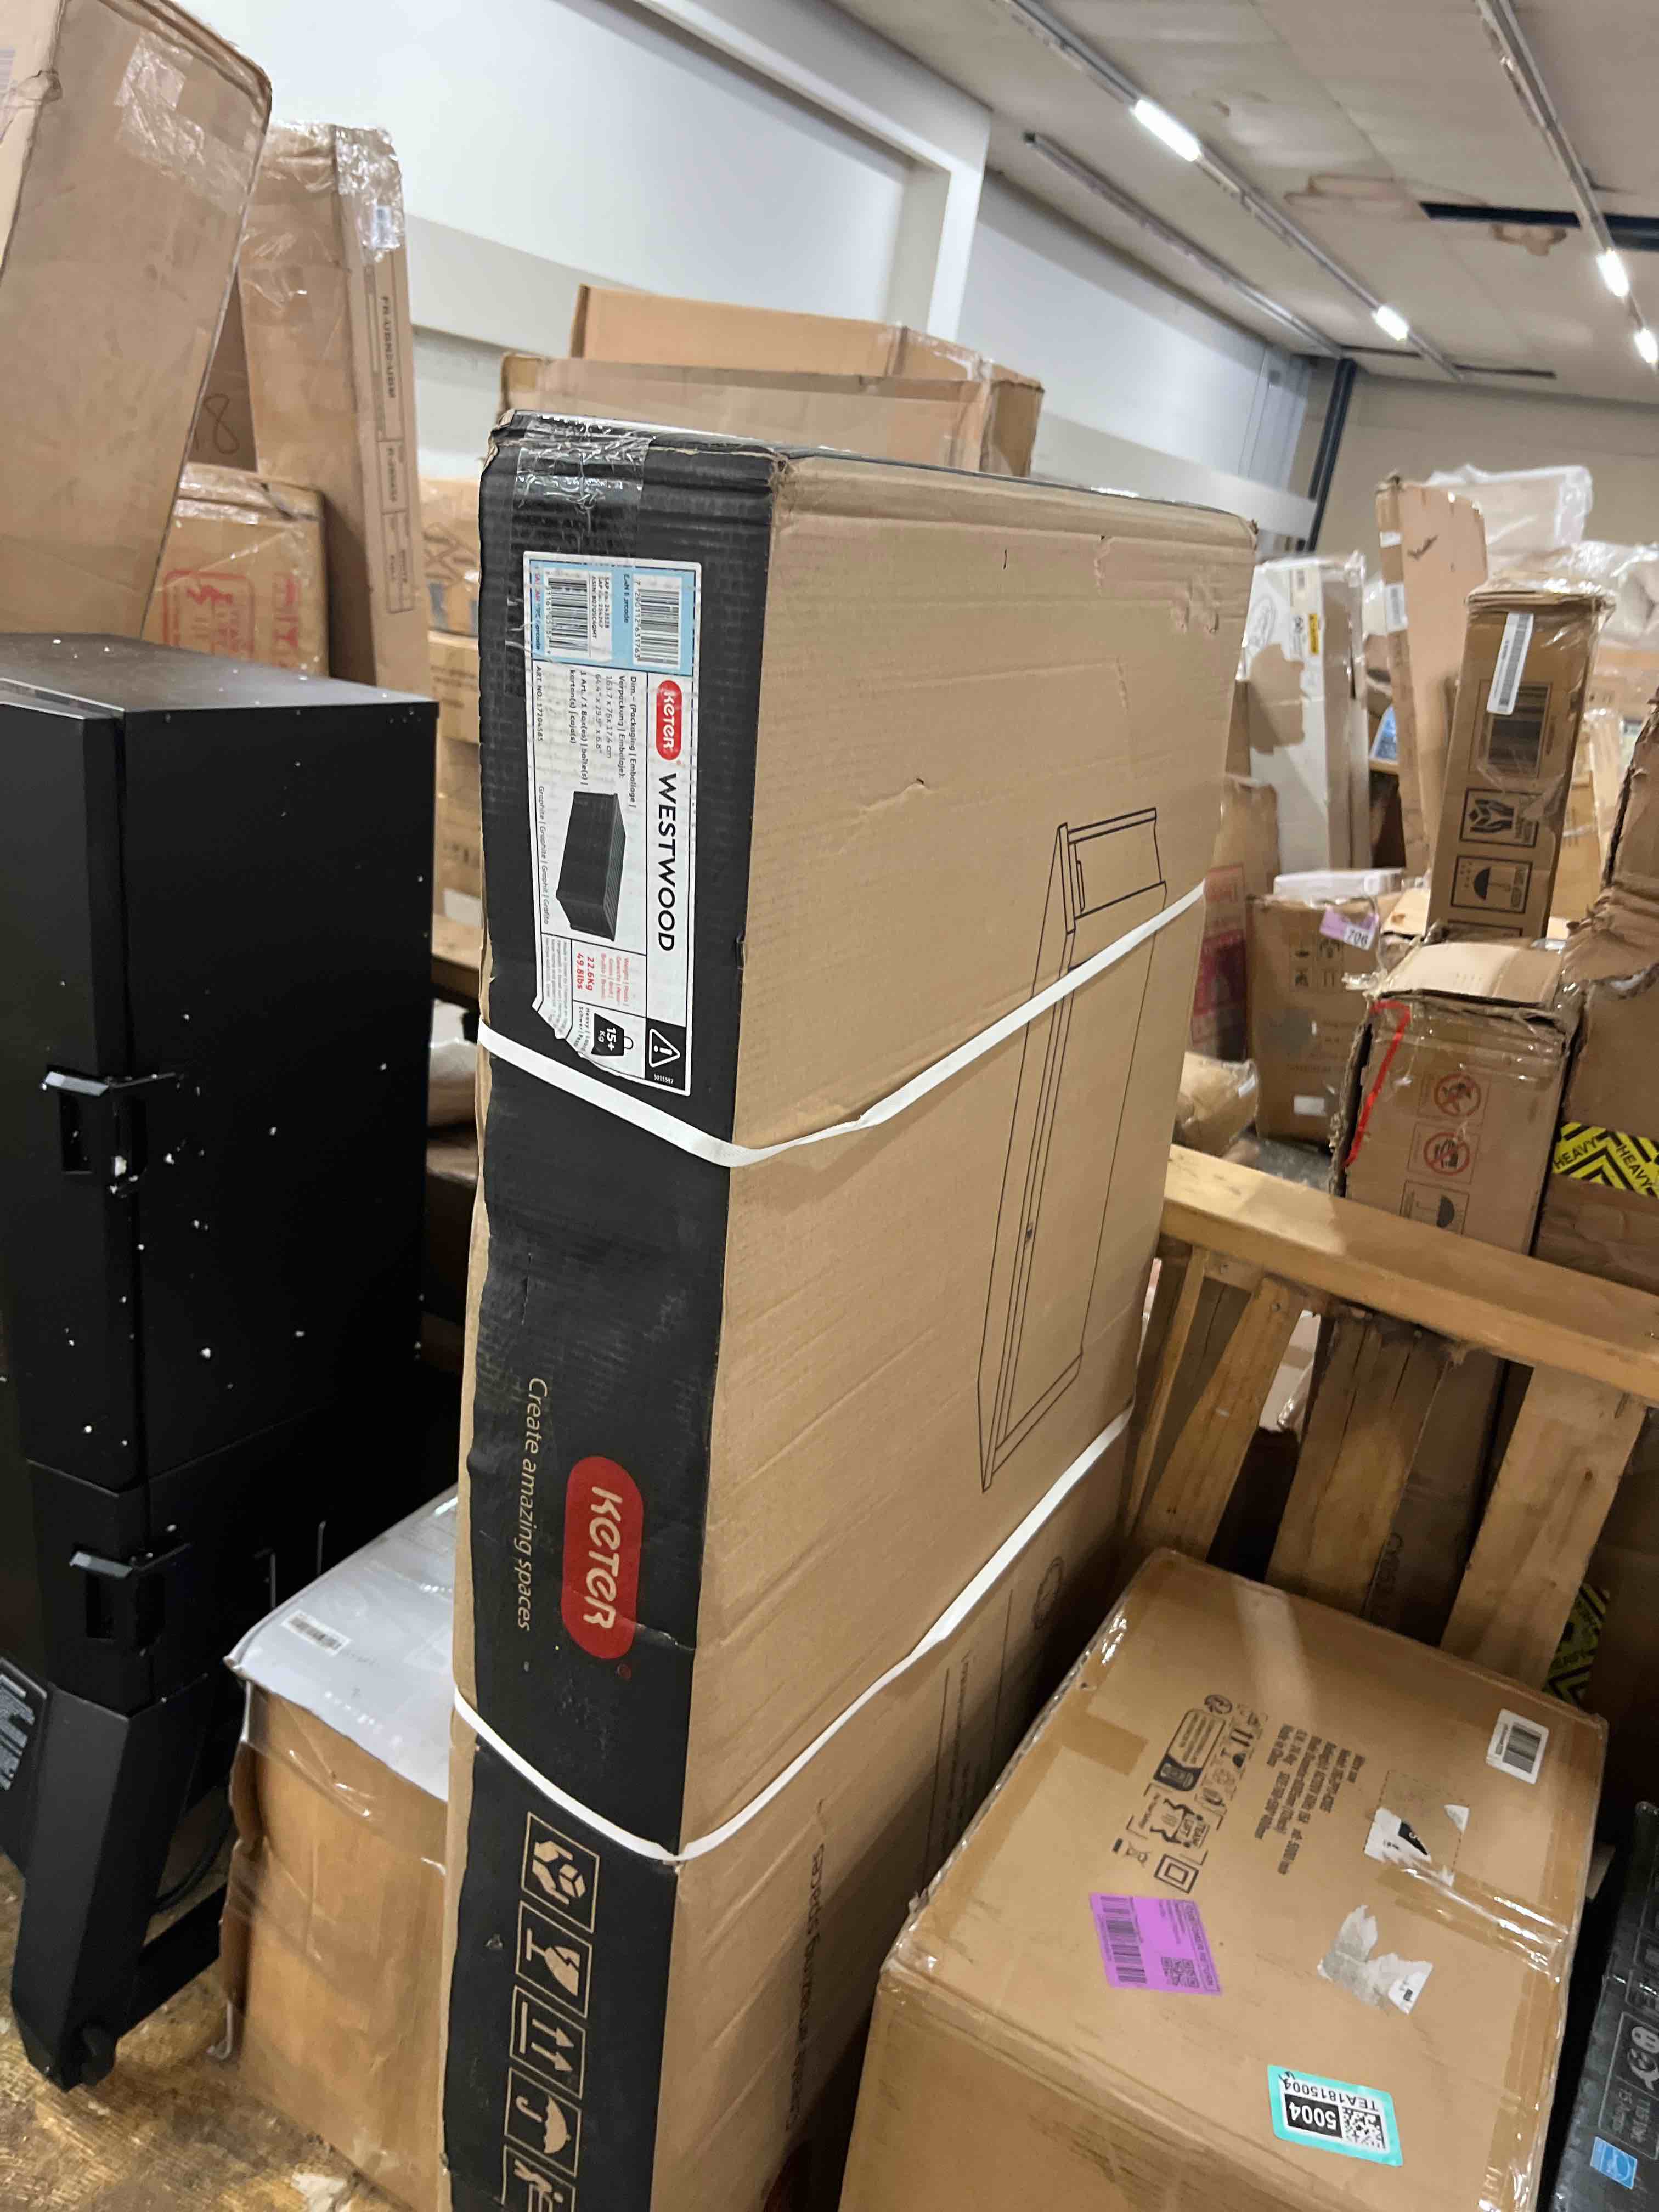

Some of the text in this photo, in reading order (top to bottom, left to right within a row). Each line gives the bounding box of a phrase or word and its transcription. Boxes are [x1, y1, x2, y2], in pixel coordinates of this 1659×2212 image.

[606, 746, 611, 758] cm
[658, 773, 676, 951] WESTWOOD
[586, 956, 594, 991] 22.6Kg
[598, 1031, 605, 1043] Kg
[606, 1028, 617, 1051] 15+
[1554, 1137, 1597, 1170] HEAVY
[1616, 1144, 1653, 1187] HEAVY
[514, 1377, 548, 1632] Create amazing spaces
[807, 1842, 824, 1935] spaces
[1283, 2081, 1379, 2112] TEA1815004
[1288, 2101, 1337, 2131] 5004
